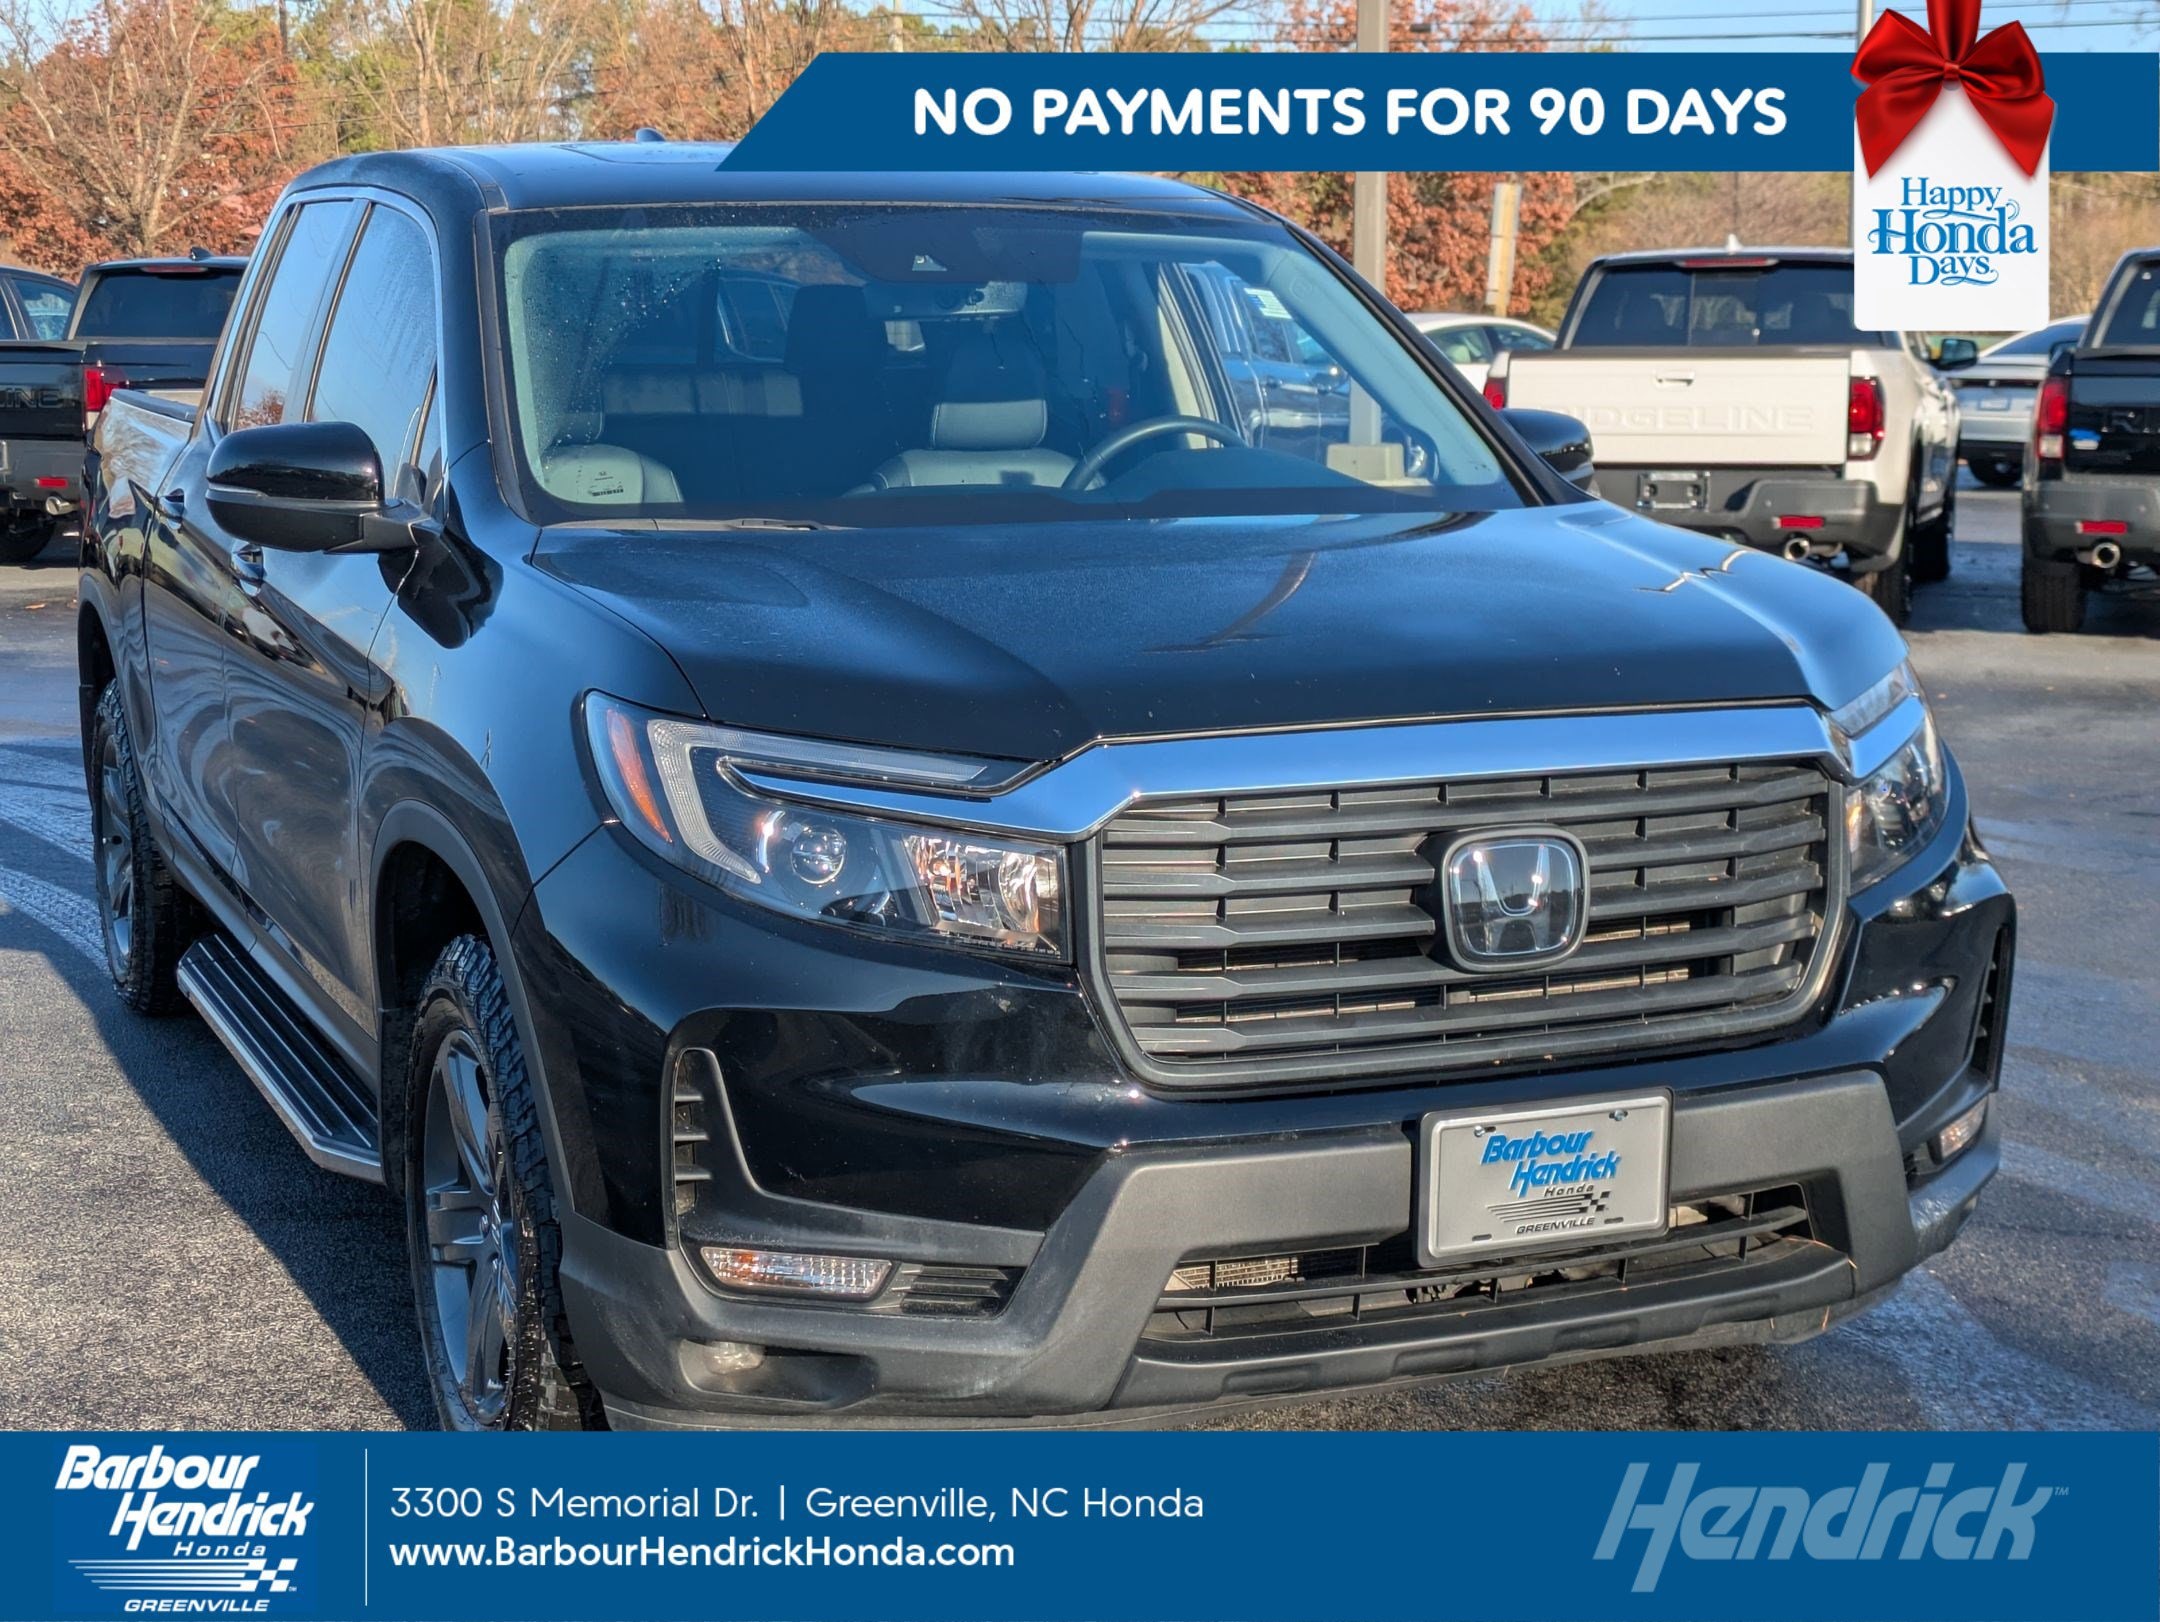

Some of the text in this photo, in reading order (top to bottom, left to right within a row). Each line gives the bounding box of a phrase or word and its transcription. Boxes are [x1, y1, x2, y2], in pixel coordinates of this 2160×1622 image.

[1480, 1129, 1594, 1165] Barbour
[1508, 1150, 1622, 1199] Hendrick
[1543, 1183, 1595, 1198] Honda
[1515, 1217, 1596, 1235] GREENVILLE
